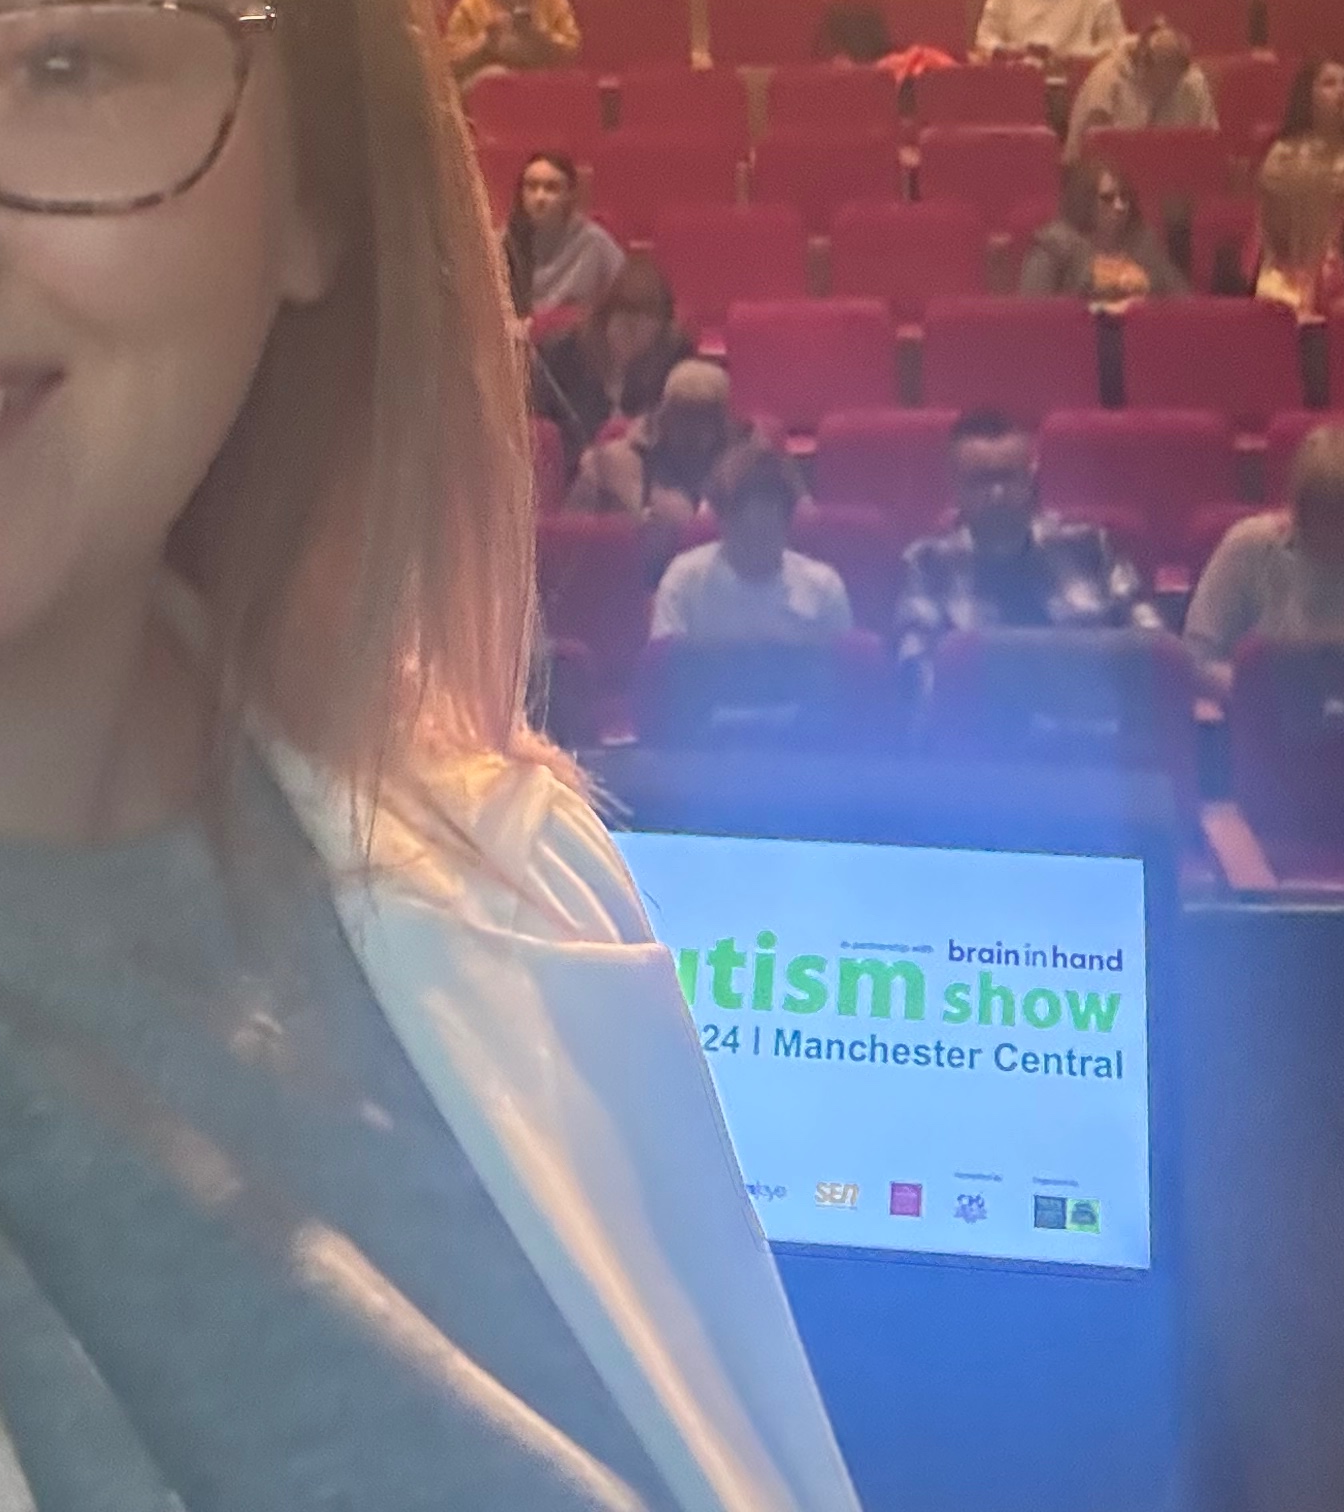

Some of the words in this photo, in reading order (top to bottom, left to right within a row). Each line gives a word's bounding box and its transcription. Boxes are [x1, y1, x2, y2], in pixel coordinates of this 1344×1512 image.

[942, 971, 1122, 1033] show
[773, 1027, 983, 1070] Manchester
[994, 1042, 1124, 1080] Central
